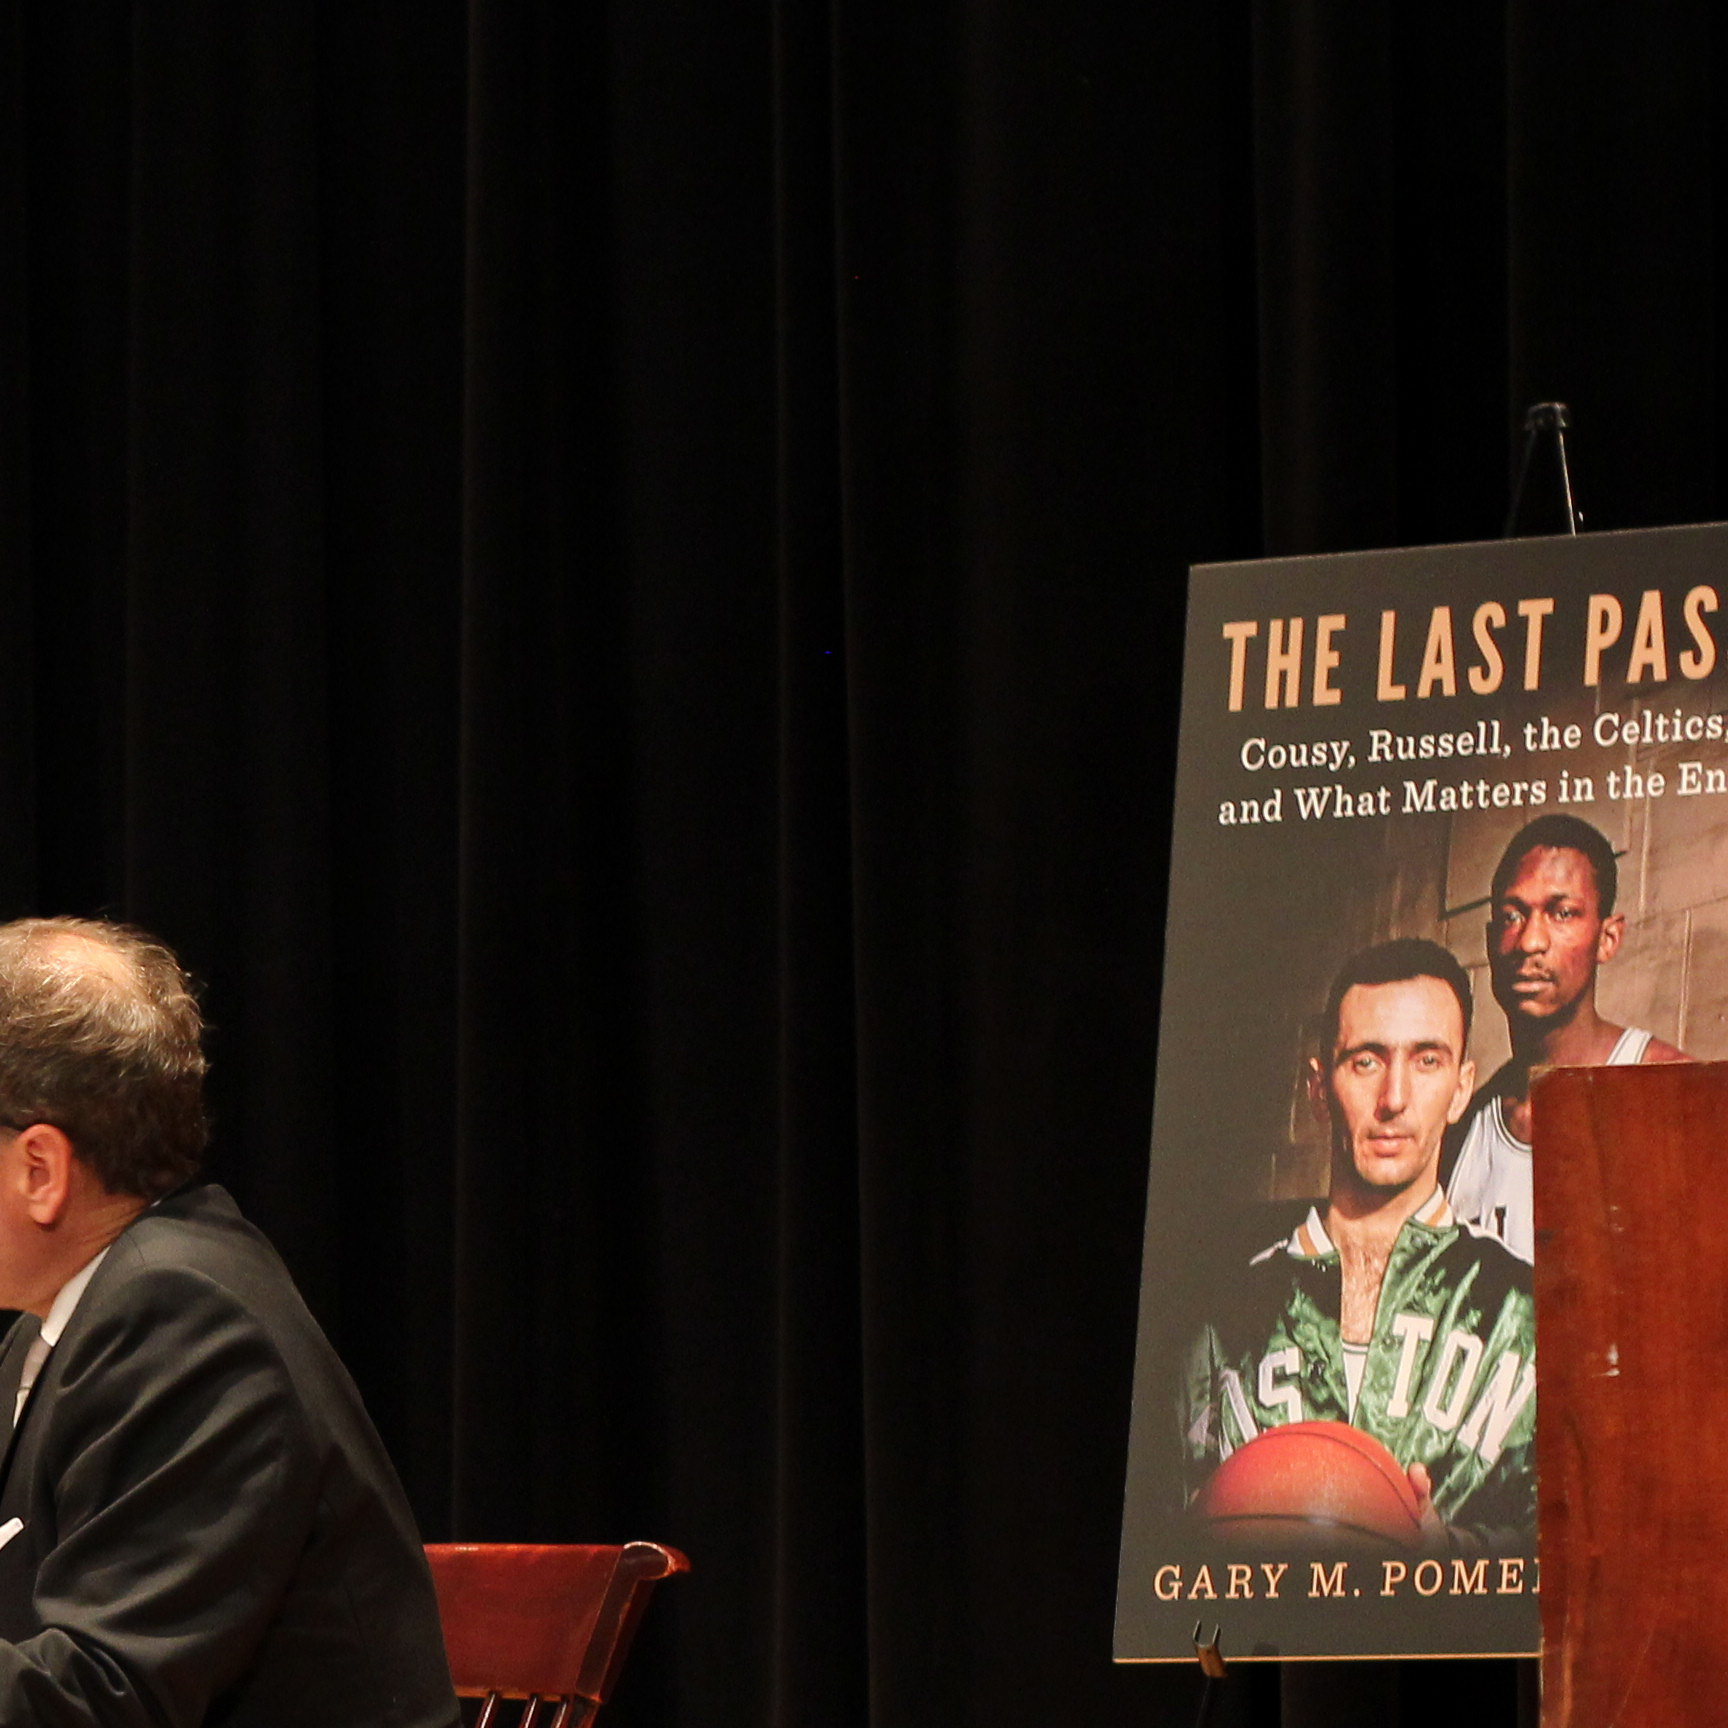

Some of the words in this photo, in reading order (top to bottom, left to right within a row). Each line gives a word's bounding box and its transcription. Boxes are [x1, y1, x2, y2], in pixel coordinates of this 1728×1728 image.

[1222, 614, 1345, 711] THE
[1377, 598, 1554, 701] LAST
[1584, 585, 1728, 686] PAS
[1241, 736, 1355, 770] Cousy,
[1367, 721, 1511, 762] Russell,
[1523, 717, 1581, 749] the
[1218, 789, 1282, 825] and
[1295, 785, 1390, 819] What
[1402, 779, 1545, 814] Matters
[1557, 771, 1594, 803] in
[1607, 766, 1665, 799] the
[1677, 761, 1728, 795] En
[1153, 1563, 1289, 1600] GARY
[1308, 1562, 1361, 1598] M.
[1380, 1557, 1540, 1597] POME
